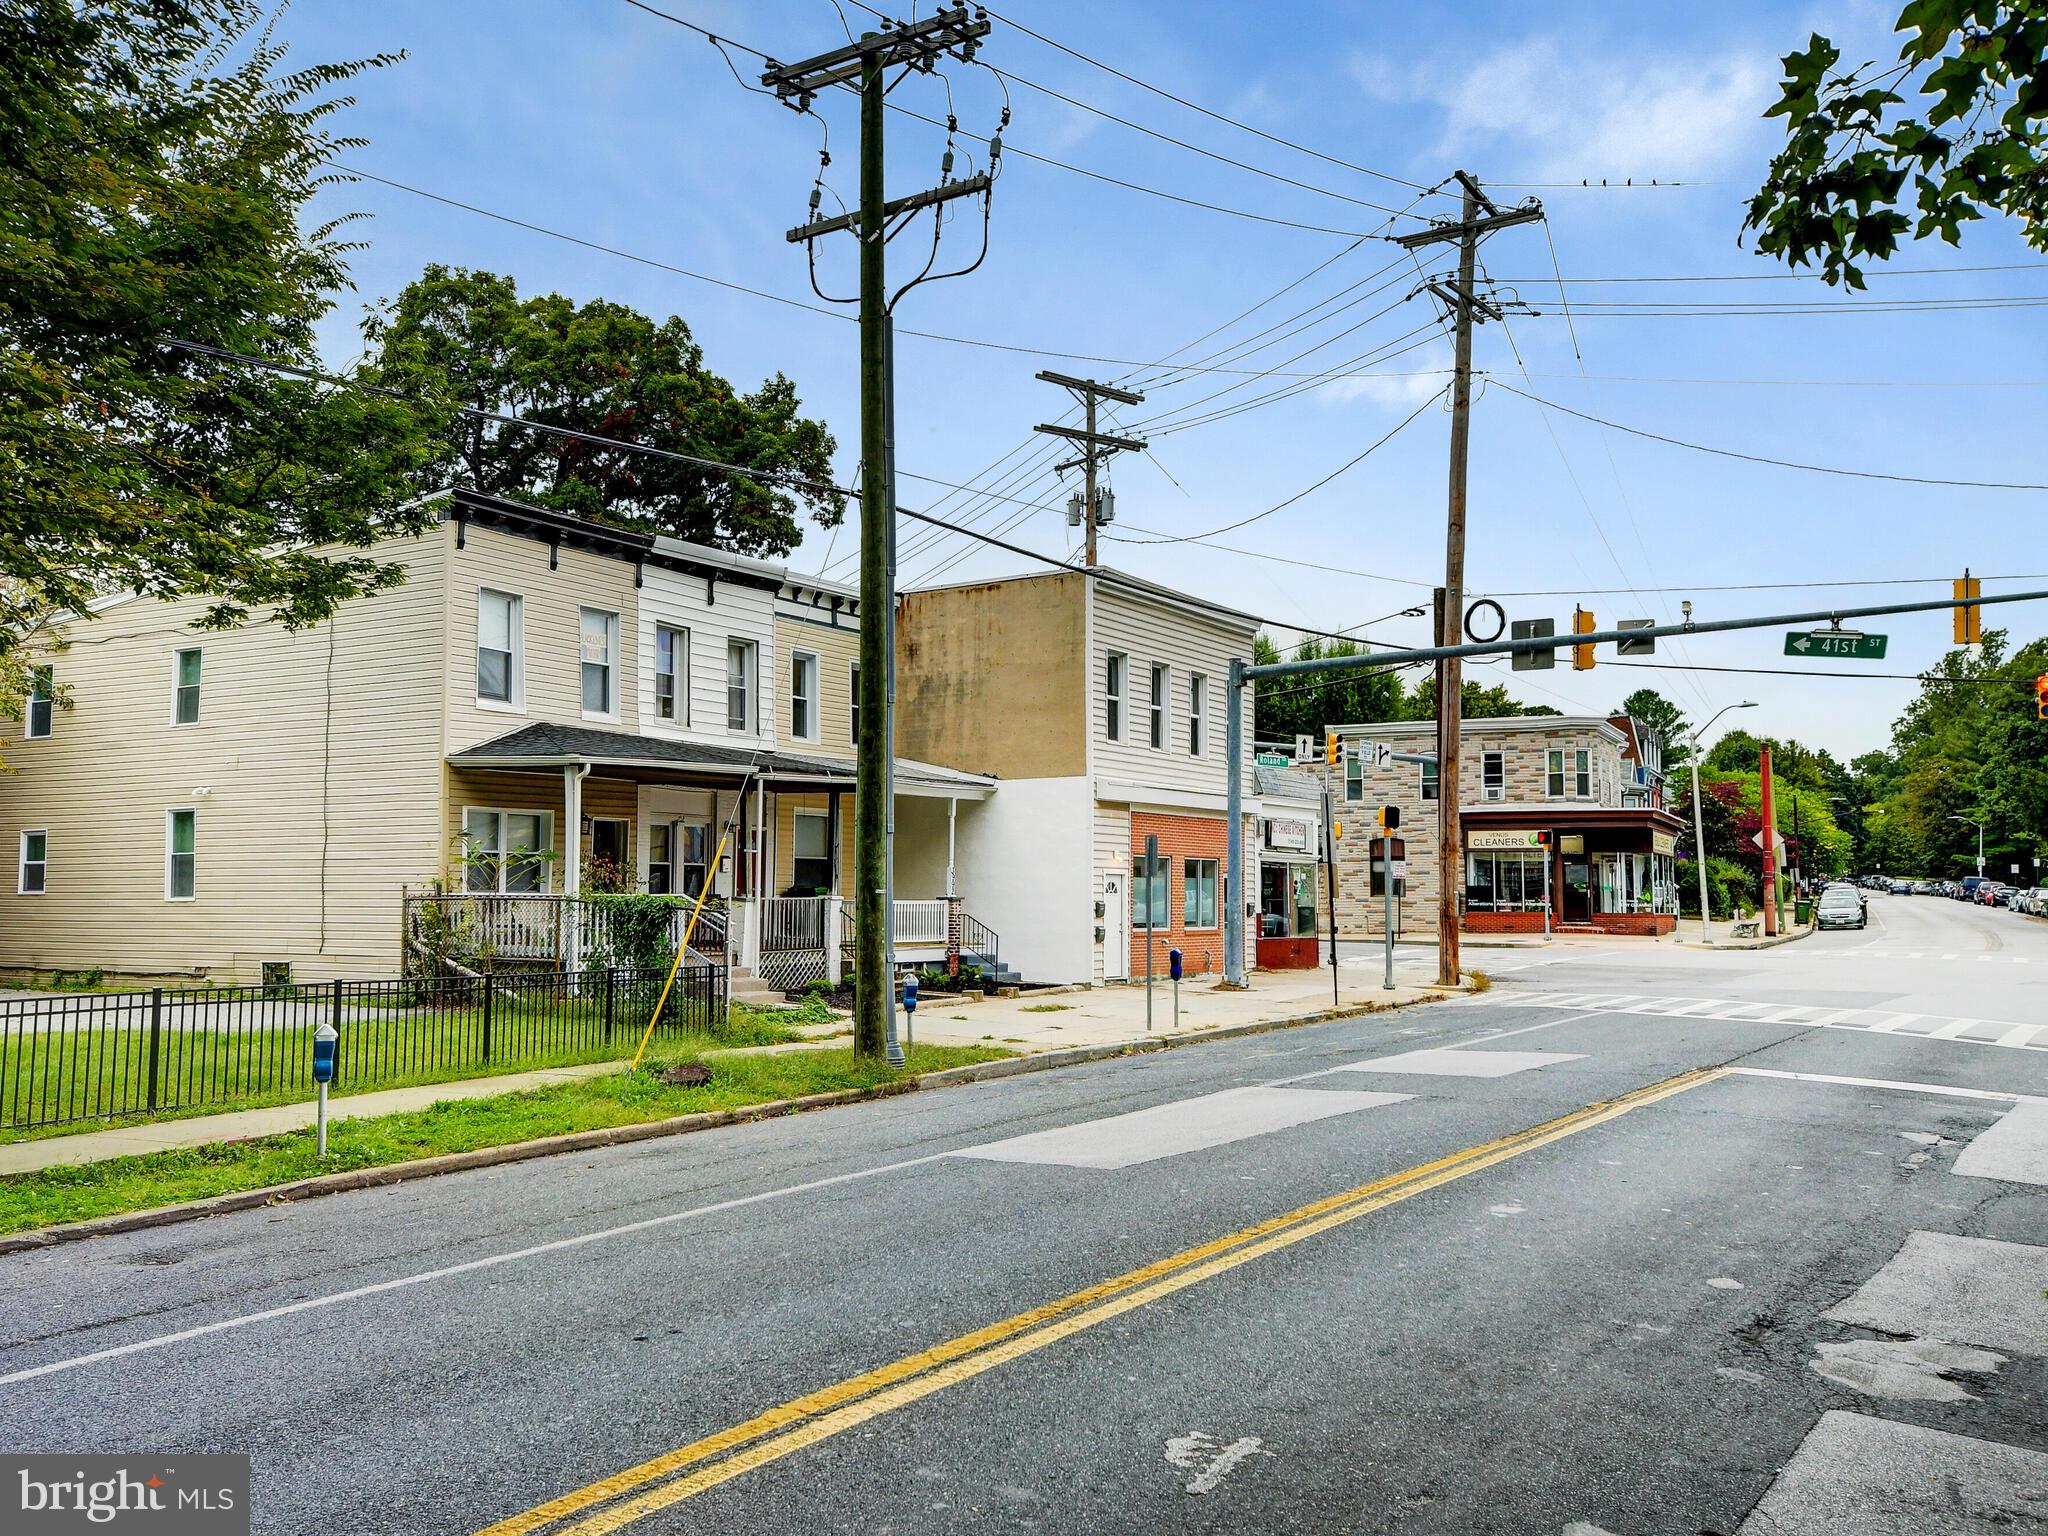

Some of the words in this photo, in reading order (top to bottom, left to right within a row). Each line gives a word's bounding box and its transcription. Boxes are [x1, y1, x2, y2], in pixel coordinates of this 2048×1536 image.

[1821, 638, 1858, 653] 41st
[1869, 638, 1881, 647] ST
[1260, 756, 1281, 765] Roland
[1473, 838, 1525, 847] CLEANERS
